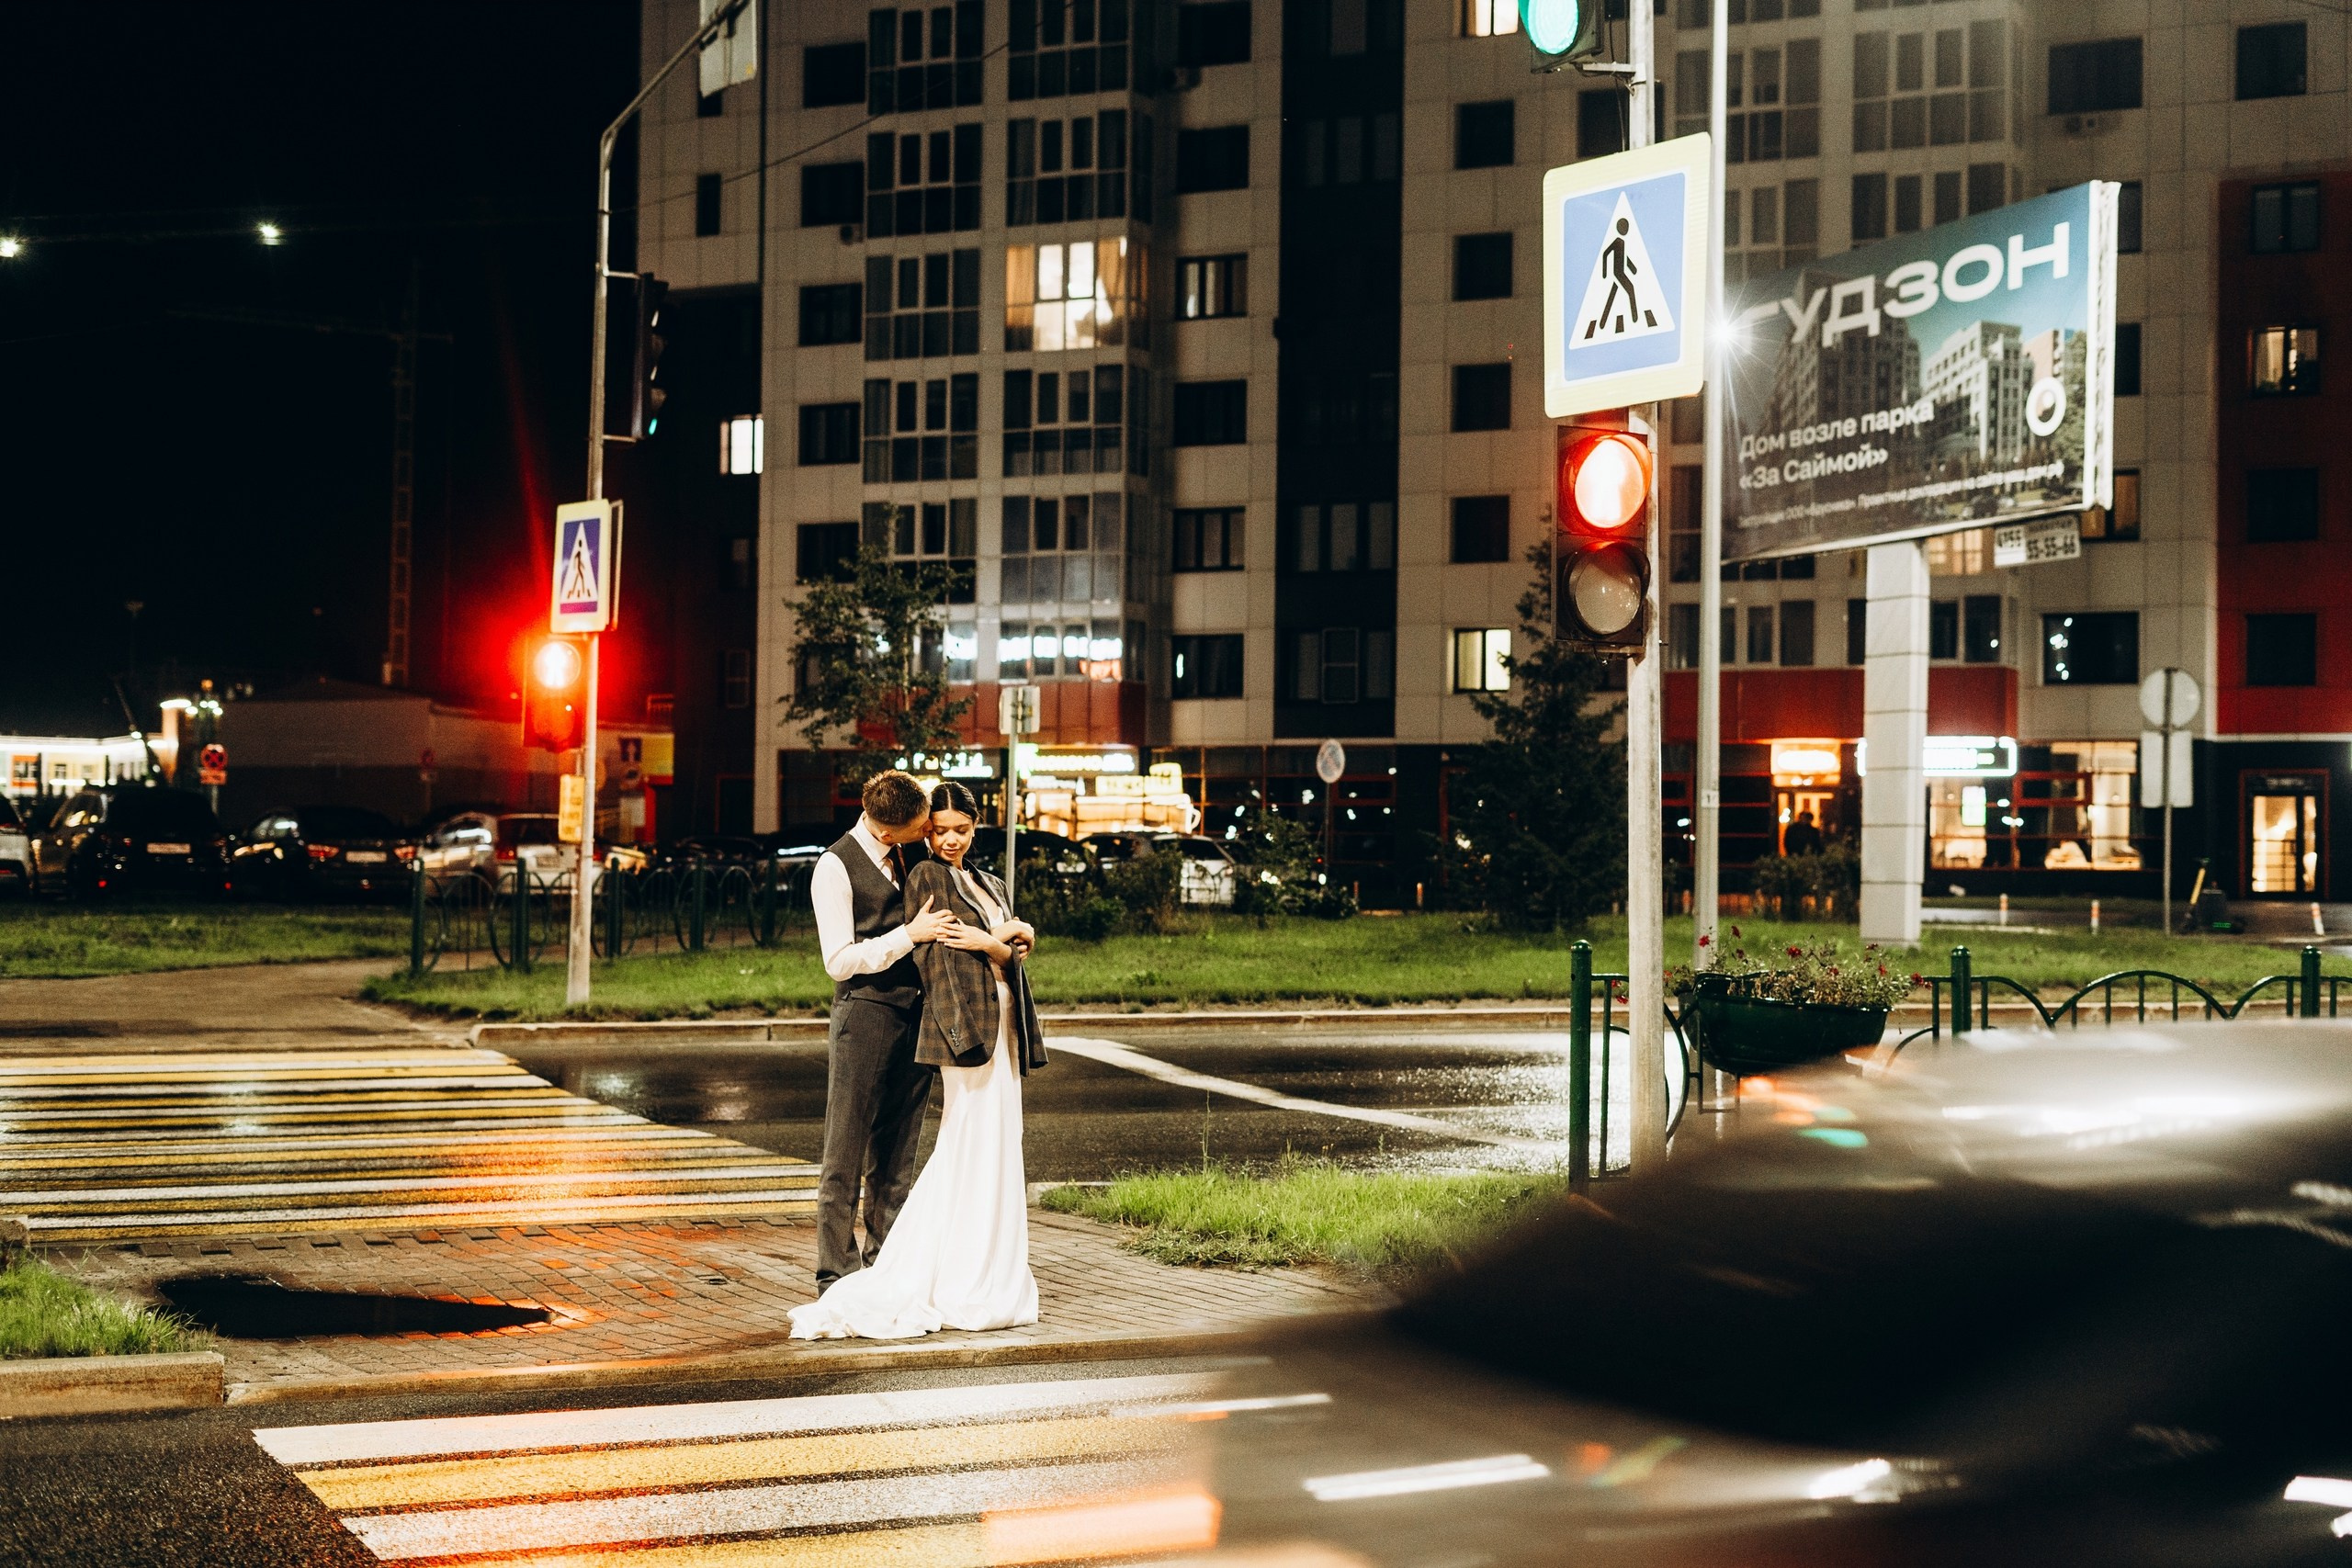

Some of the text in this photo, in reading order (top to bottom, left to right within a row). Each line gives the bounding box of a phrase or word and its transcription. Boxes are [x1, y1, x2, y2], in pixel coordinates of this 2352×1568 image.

[1739, 400, 1935, 462] Дом возле парка
[1739, 443, 1889, 490] «За Саймой»
